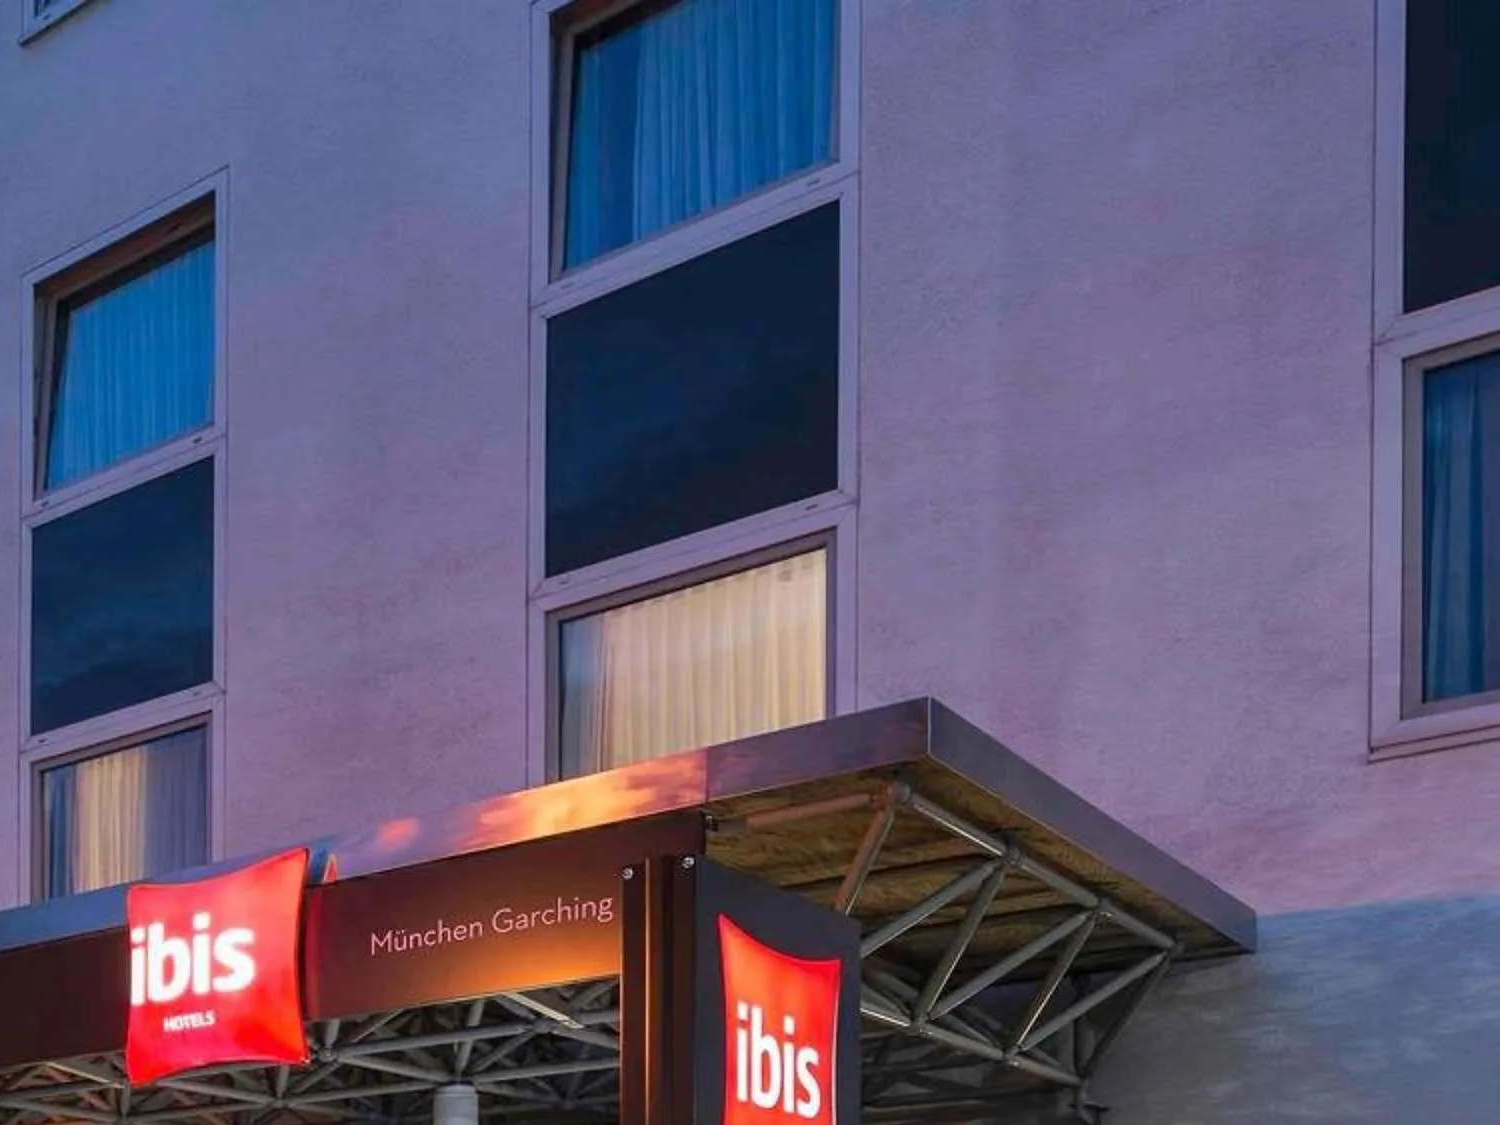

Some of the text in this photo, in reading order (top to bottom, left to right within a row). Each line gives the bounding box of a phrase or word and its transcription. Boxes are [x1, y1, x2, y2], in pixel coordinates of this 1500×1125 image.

[130, 912, 256, 1006] ibis
[370, 896, 613, 955] München Garching
[163, 1010, 216, 1032] HOTELS
[736, 1000, 821, 1119] ibis
